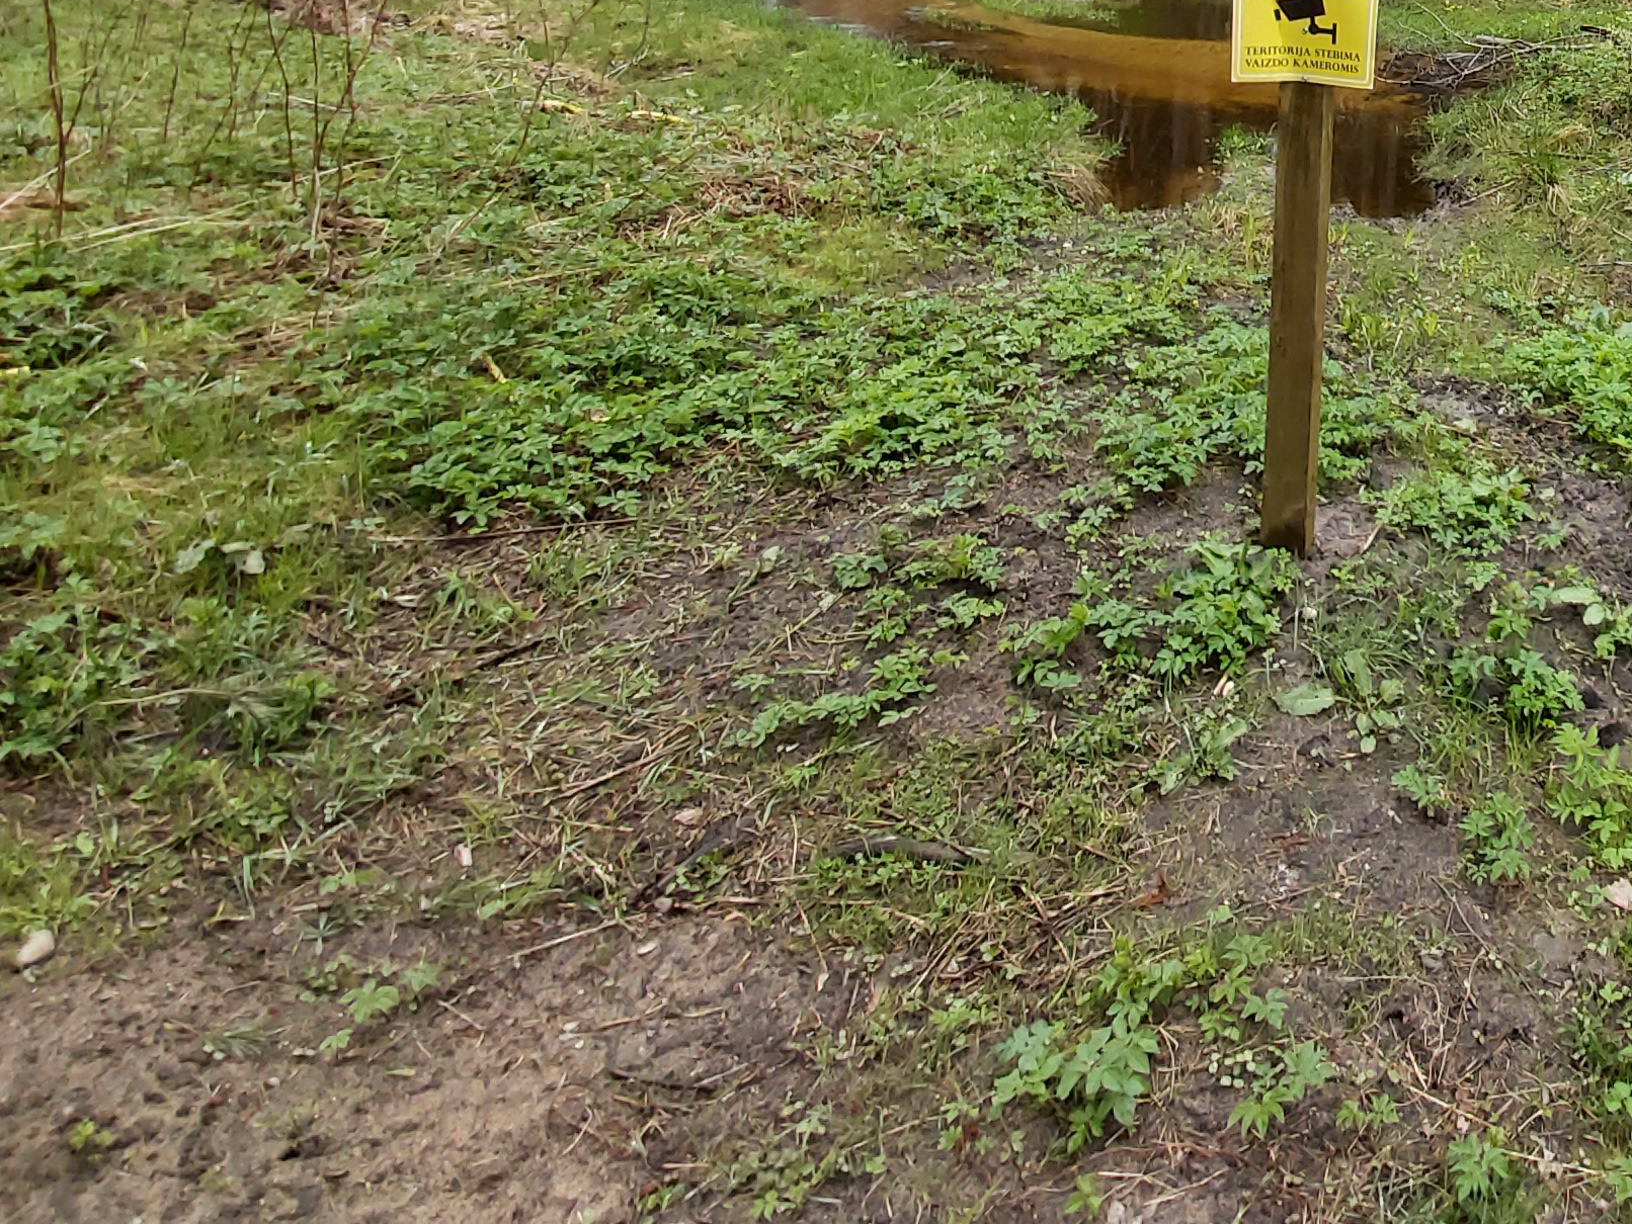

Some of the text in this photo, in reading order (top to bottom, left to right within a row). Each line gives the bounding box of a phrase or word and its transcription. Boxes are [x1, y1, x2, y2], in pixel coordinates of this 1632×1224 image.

[1245, 46, 1361, 62] TERITORIJA STEBIMA
[1245, 58, 1360, 73] VAIZDO KAMEROMIS
